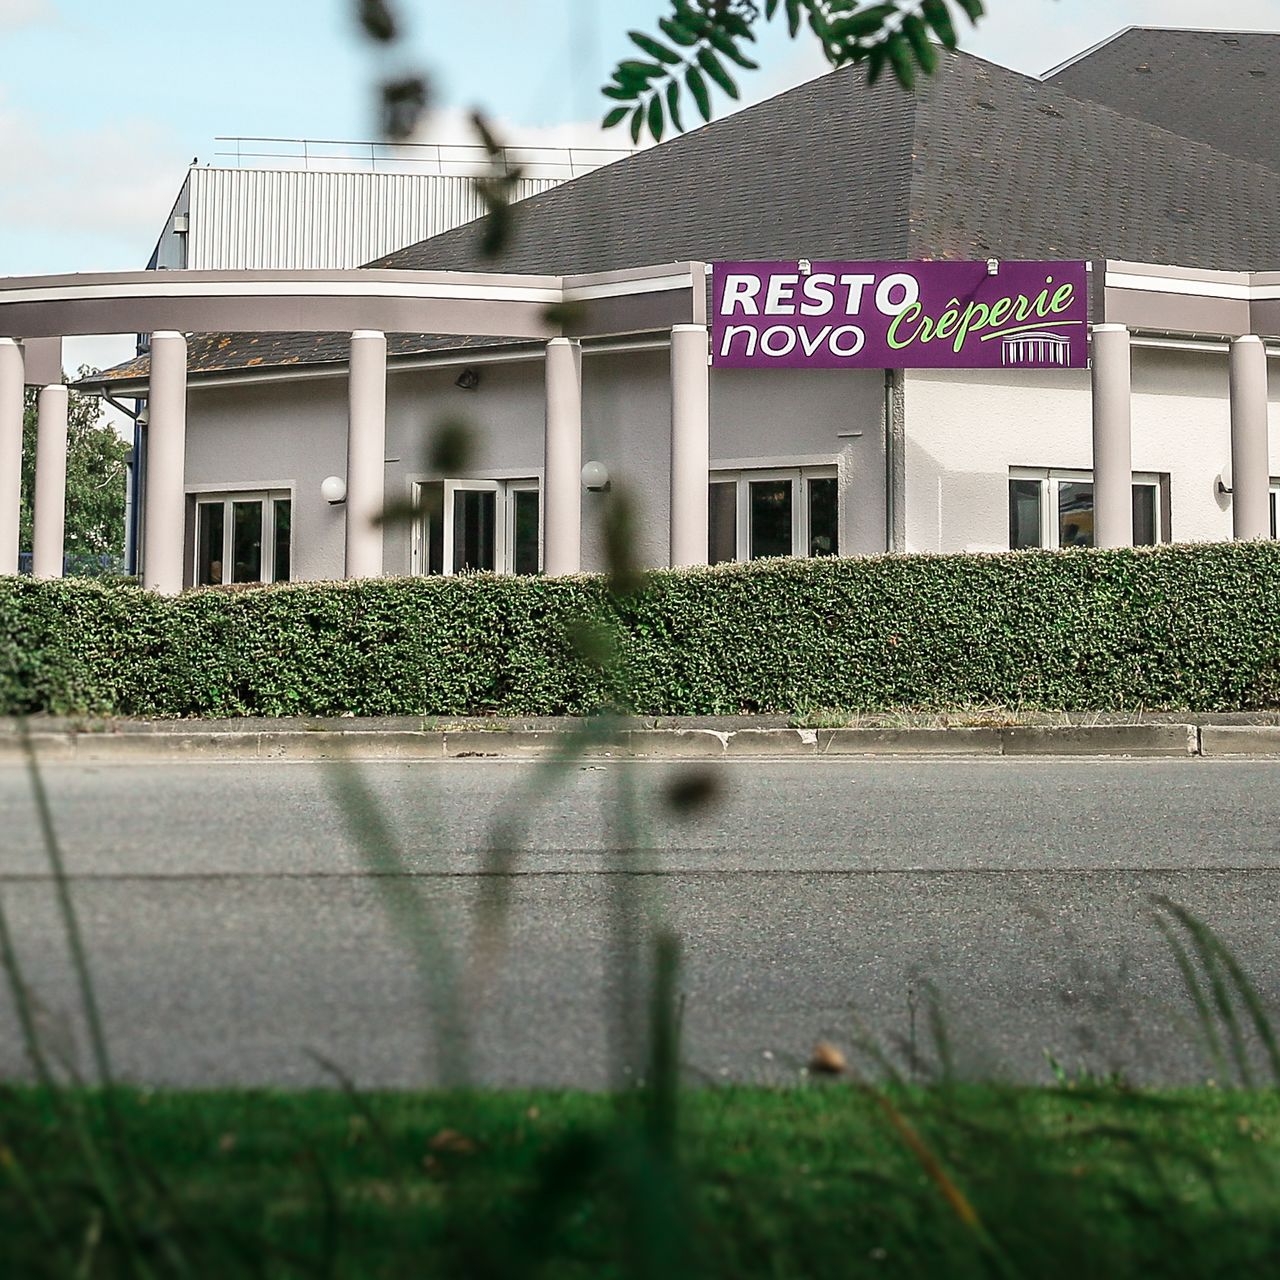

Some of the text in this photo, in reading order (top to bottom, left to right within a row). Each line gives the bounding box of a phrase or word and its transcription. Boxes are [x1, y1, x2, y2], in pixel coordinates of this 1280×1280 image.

[720, 274, 919, 316] RESTO
[887, 275, 1075, 352] Crêperie
[720, 324, 866, 357] novo
